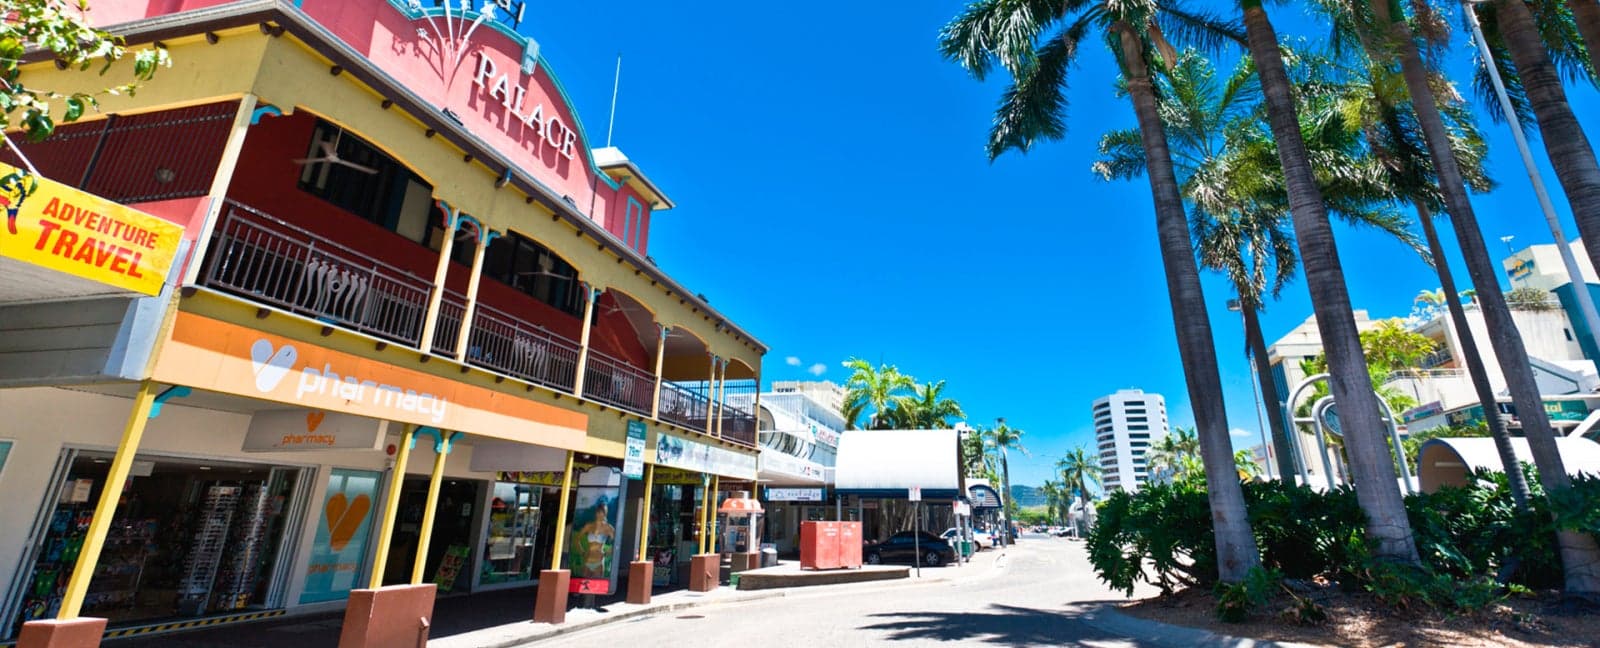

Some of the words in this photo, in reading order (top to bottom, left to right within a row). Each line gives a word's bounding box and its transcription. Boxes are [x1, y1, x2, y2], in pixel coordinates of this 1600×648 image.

[473, 50, 576, 161] PALACE
[34, 219, 143, 279] TRAVEL
[42, 197, 159, 249] ADVENTURE
[296, 363, 447, 423] pharmacy
[282, 433, 336, 446] pharmacy
